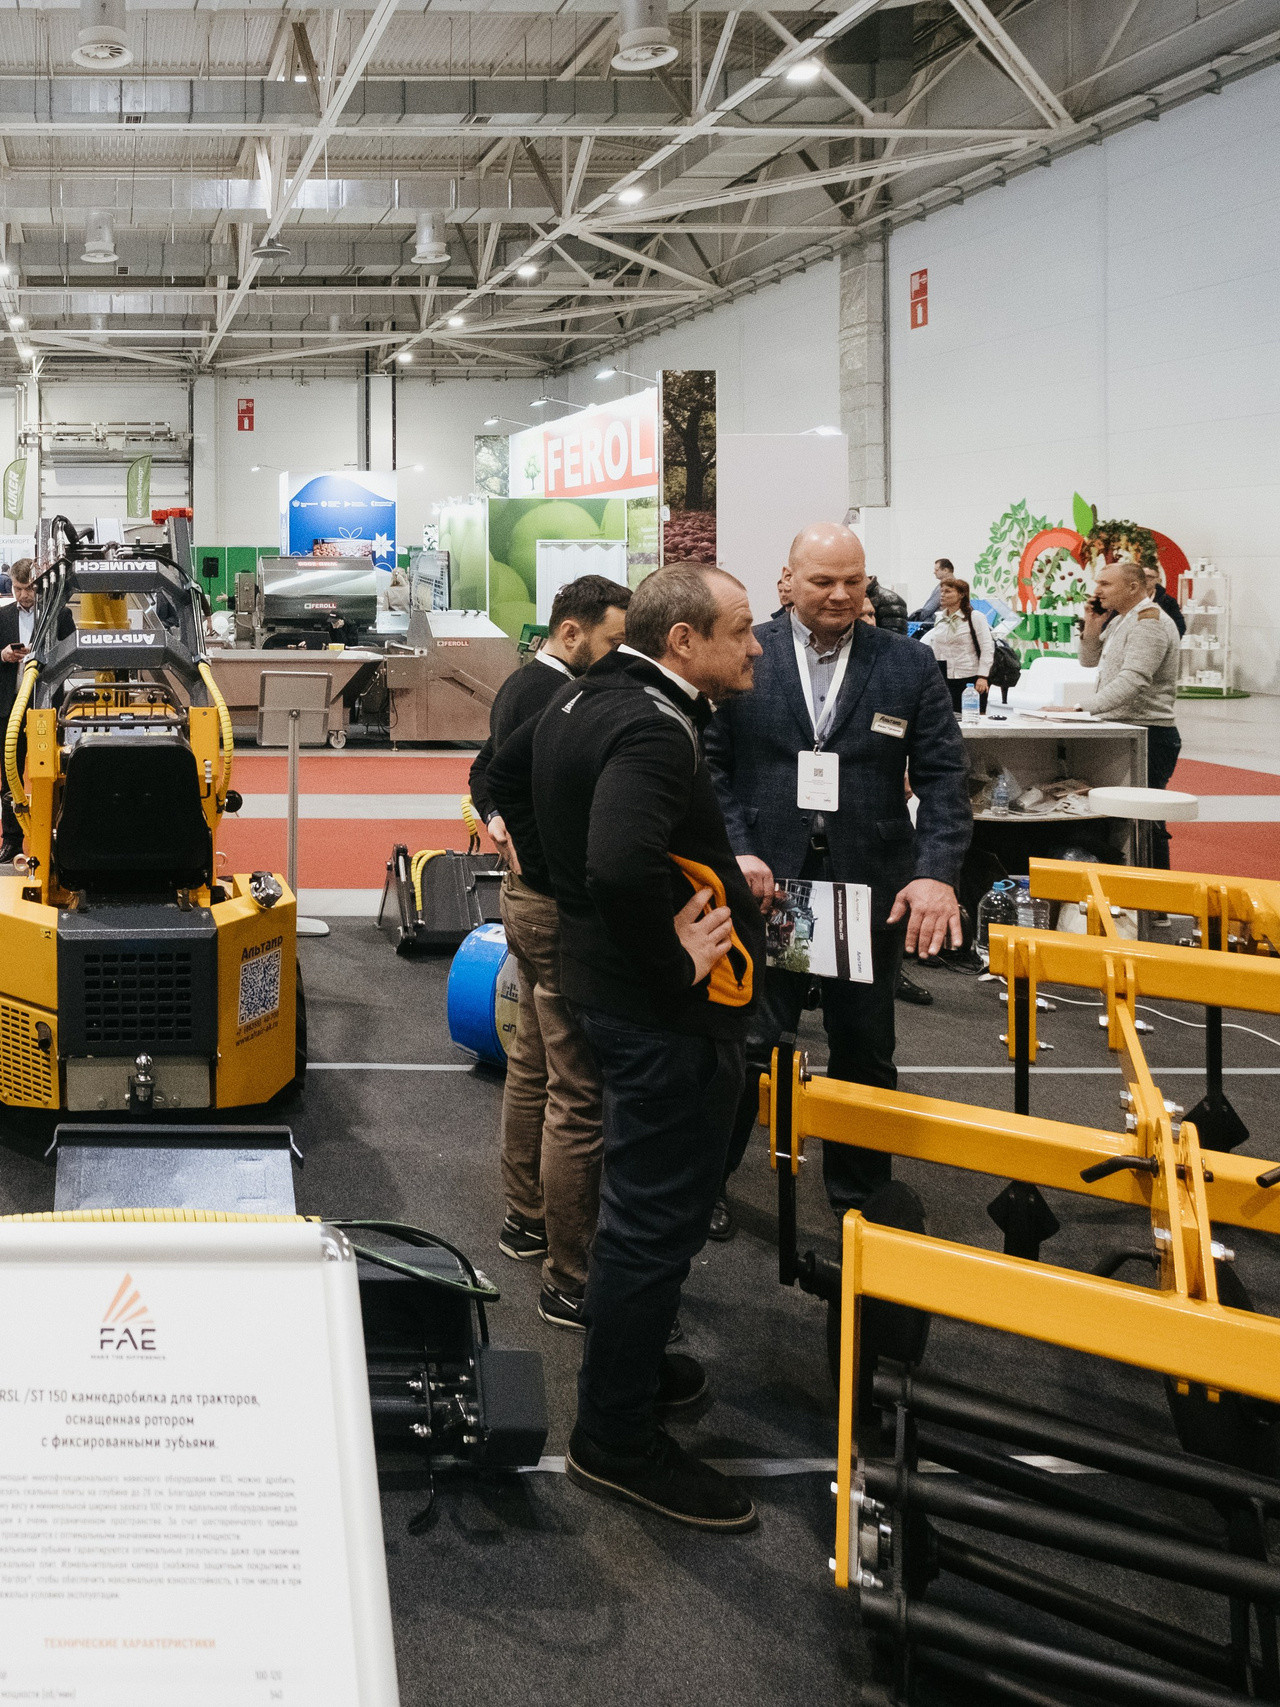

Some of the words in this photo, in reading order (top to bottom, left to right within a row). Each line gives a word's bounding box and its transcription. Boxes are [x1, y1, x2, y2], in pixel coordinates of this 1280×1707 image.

[547, 415, 659, 492] FEROL
[7, 470, 20, 515] KUKER
[75, 561, 157, 571] BAUMECH
[81, 633, 155, 645] Альтаир
[241, 935, 283, 961] Альтаир
[100, 1328, 157, 1351] FAE
[0, 1389, 20, 1403] RSL
[24, 1388, 45, 1405] /ST
[48, 1390, 68, 1403] 150
[71, 1389, 167, 1405] камнедробилка
[170, 1393, 193, 1405] для
[195, 1393, 261, 1406] тракторов,
[65, 1414, 141, 1427] оснащенная
[144, 1414, 195, 1427] ротором
[41, 1437, 48, 1448] с
[51, 1434, 161, 1450] фиксированными
[44, 1637, 118, 1650] ТЕХНИЧЕСКИЕ
[122, 1637, 217, 1650] ХАРАКТЕРИСТИКИ
